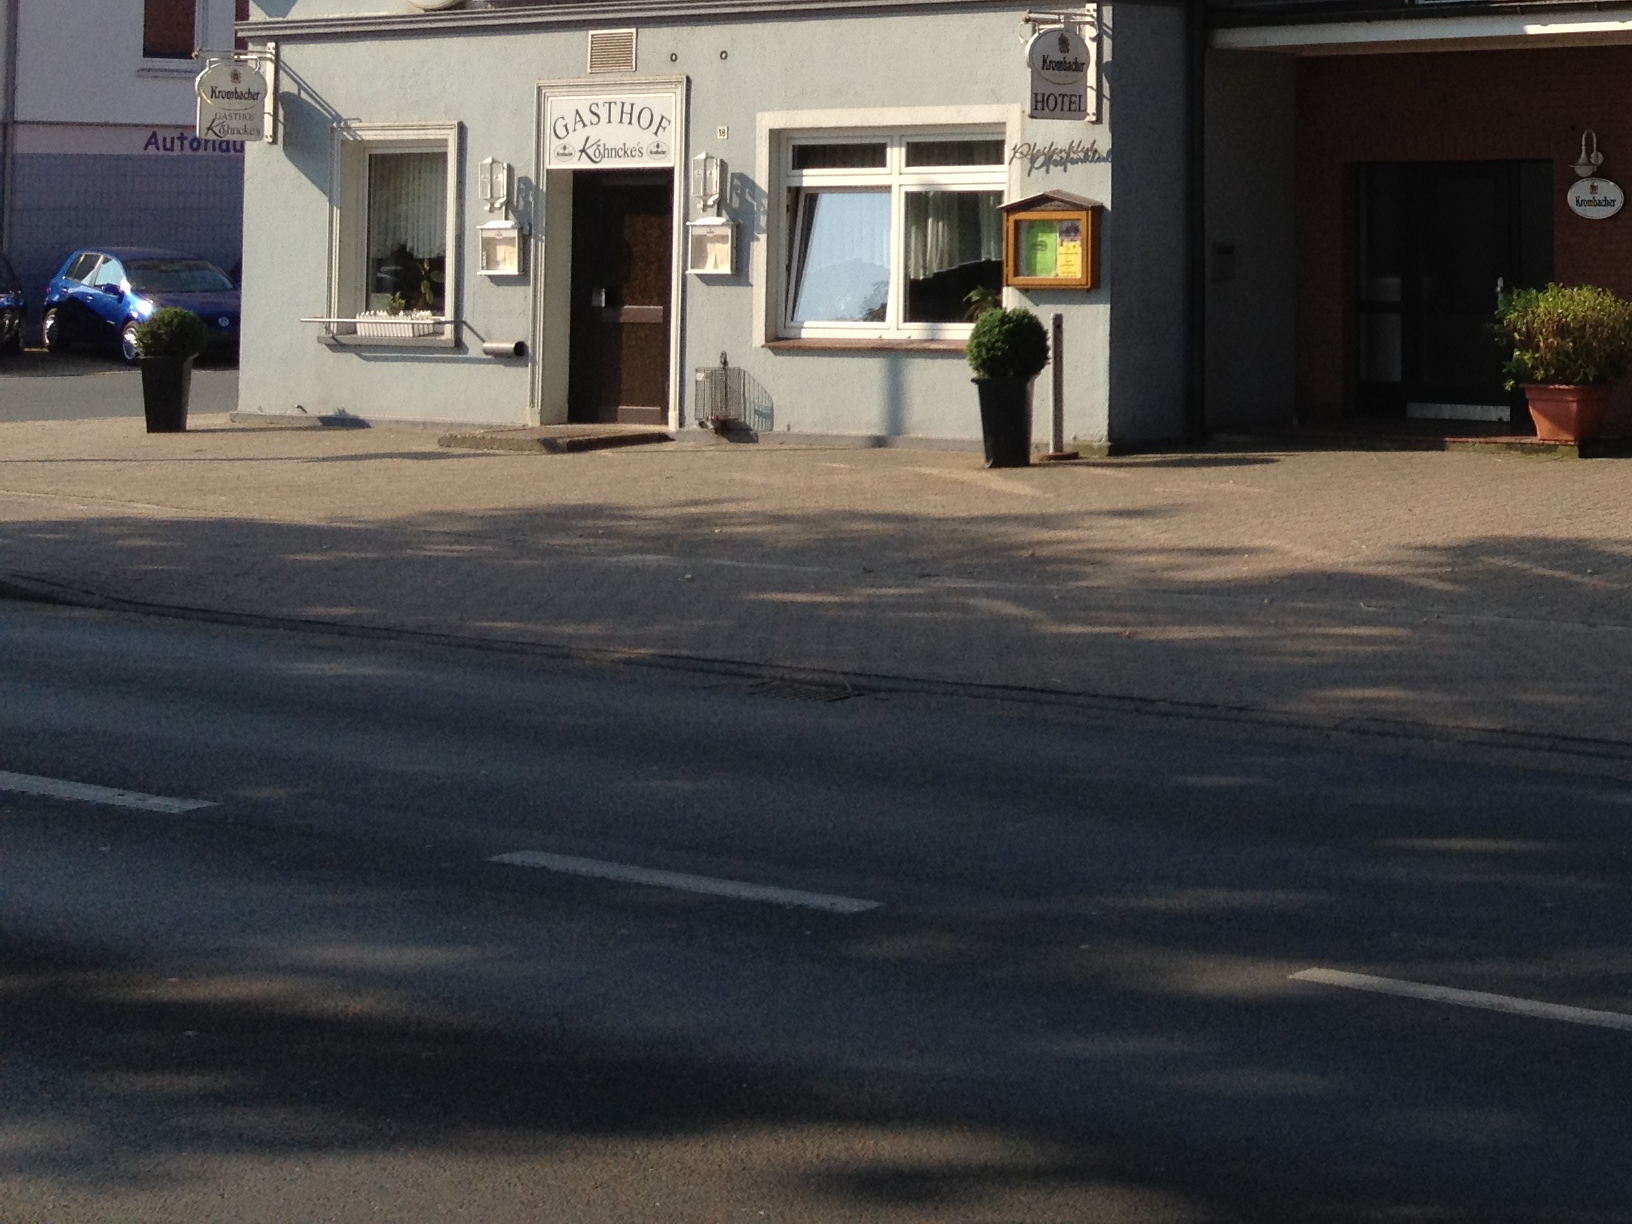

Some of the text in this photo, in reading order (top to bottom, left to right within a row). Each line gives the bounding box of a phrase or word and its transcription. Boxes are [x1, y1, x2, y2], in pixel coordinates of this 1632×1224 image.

[1041, 54, 1086, 73] Krombacher
[210, 85, 261, 101] Krombacher
[1033, 92, 1087, 113] HOTEL
[552, 100, 672, 140] GASTHOF
[577, 135, 644, 164] Köhncke's
[1575, 195, 1617, 208] Krombacher
